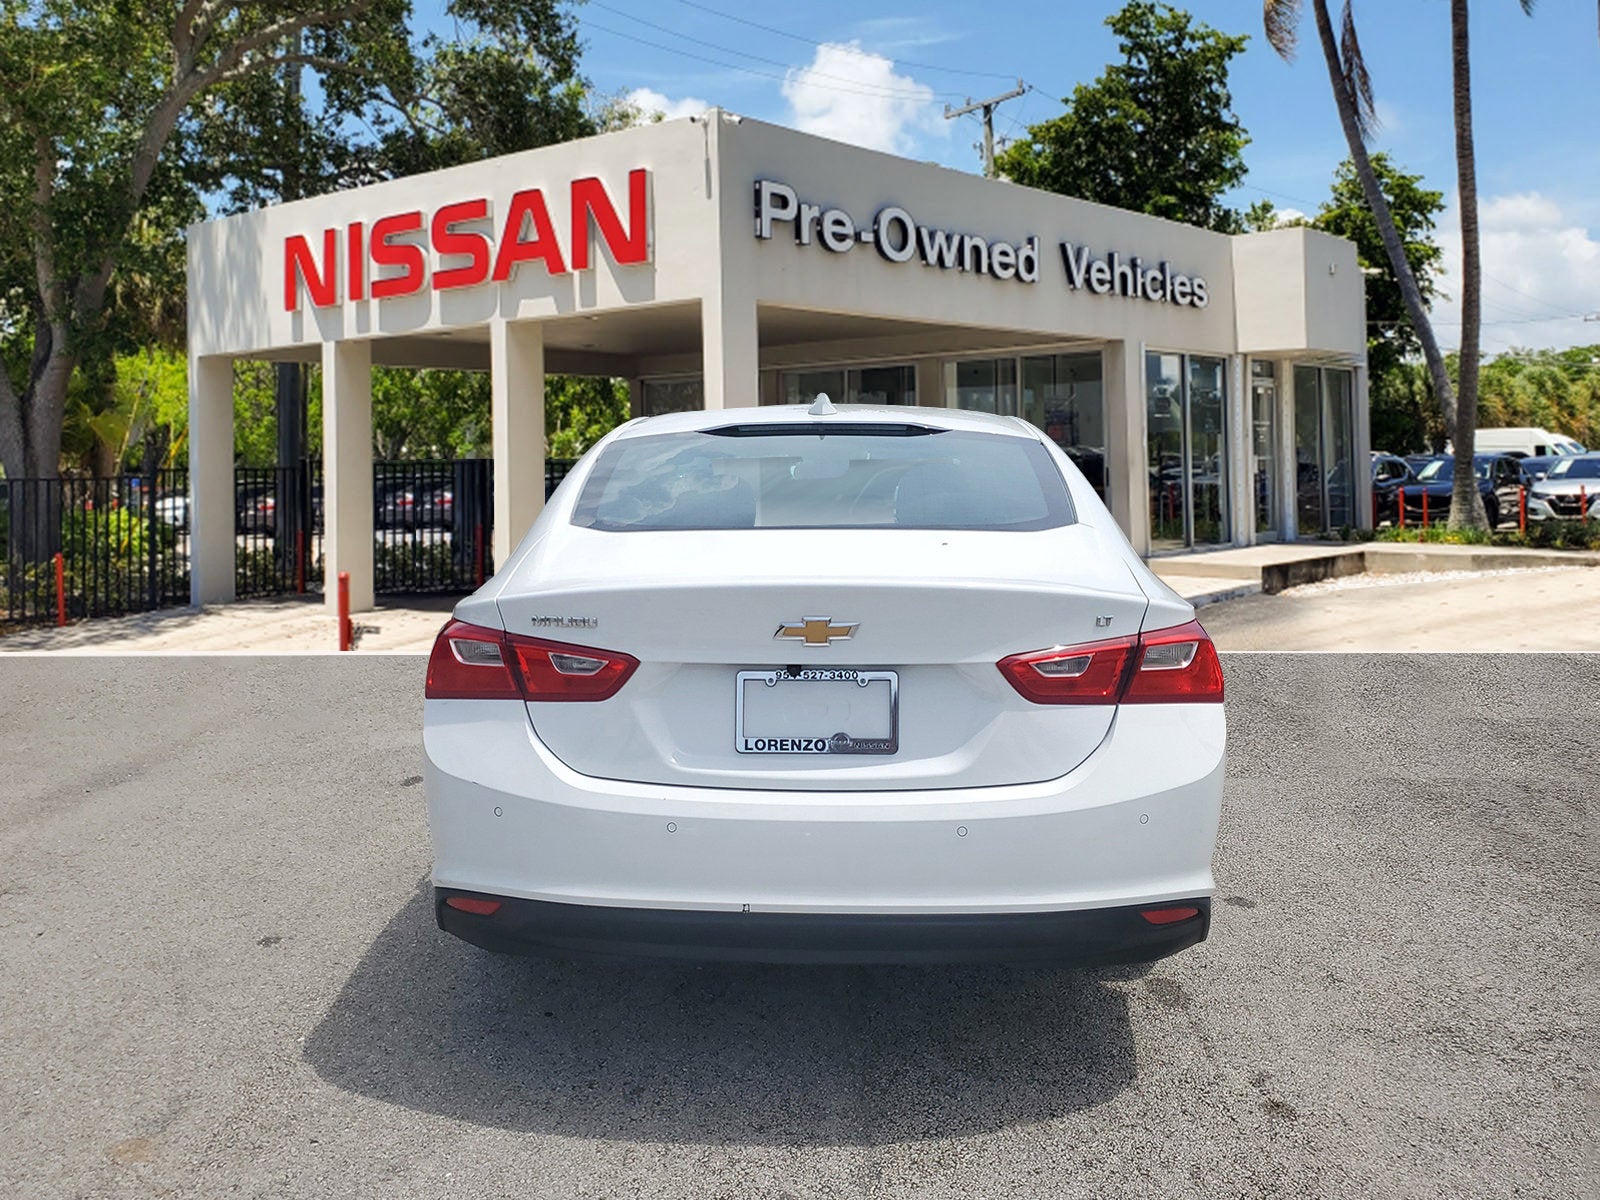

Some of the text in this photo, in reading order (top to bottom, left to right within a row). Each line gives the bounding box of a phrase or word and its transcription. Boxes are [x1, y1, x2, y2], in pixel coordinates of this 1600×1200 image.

[284, 168, 648, 312] NISSAN
[754, 179, 1209, 308] Pre-Owned Vehicles
[1095, 615, 1114, 627] LT
[775, 670, 859, 680] 95-527-3400
[744, 738, 827, 752] LORENZO
